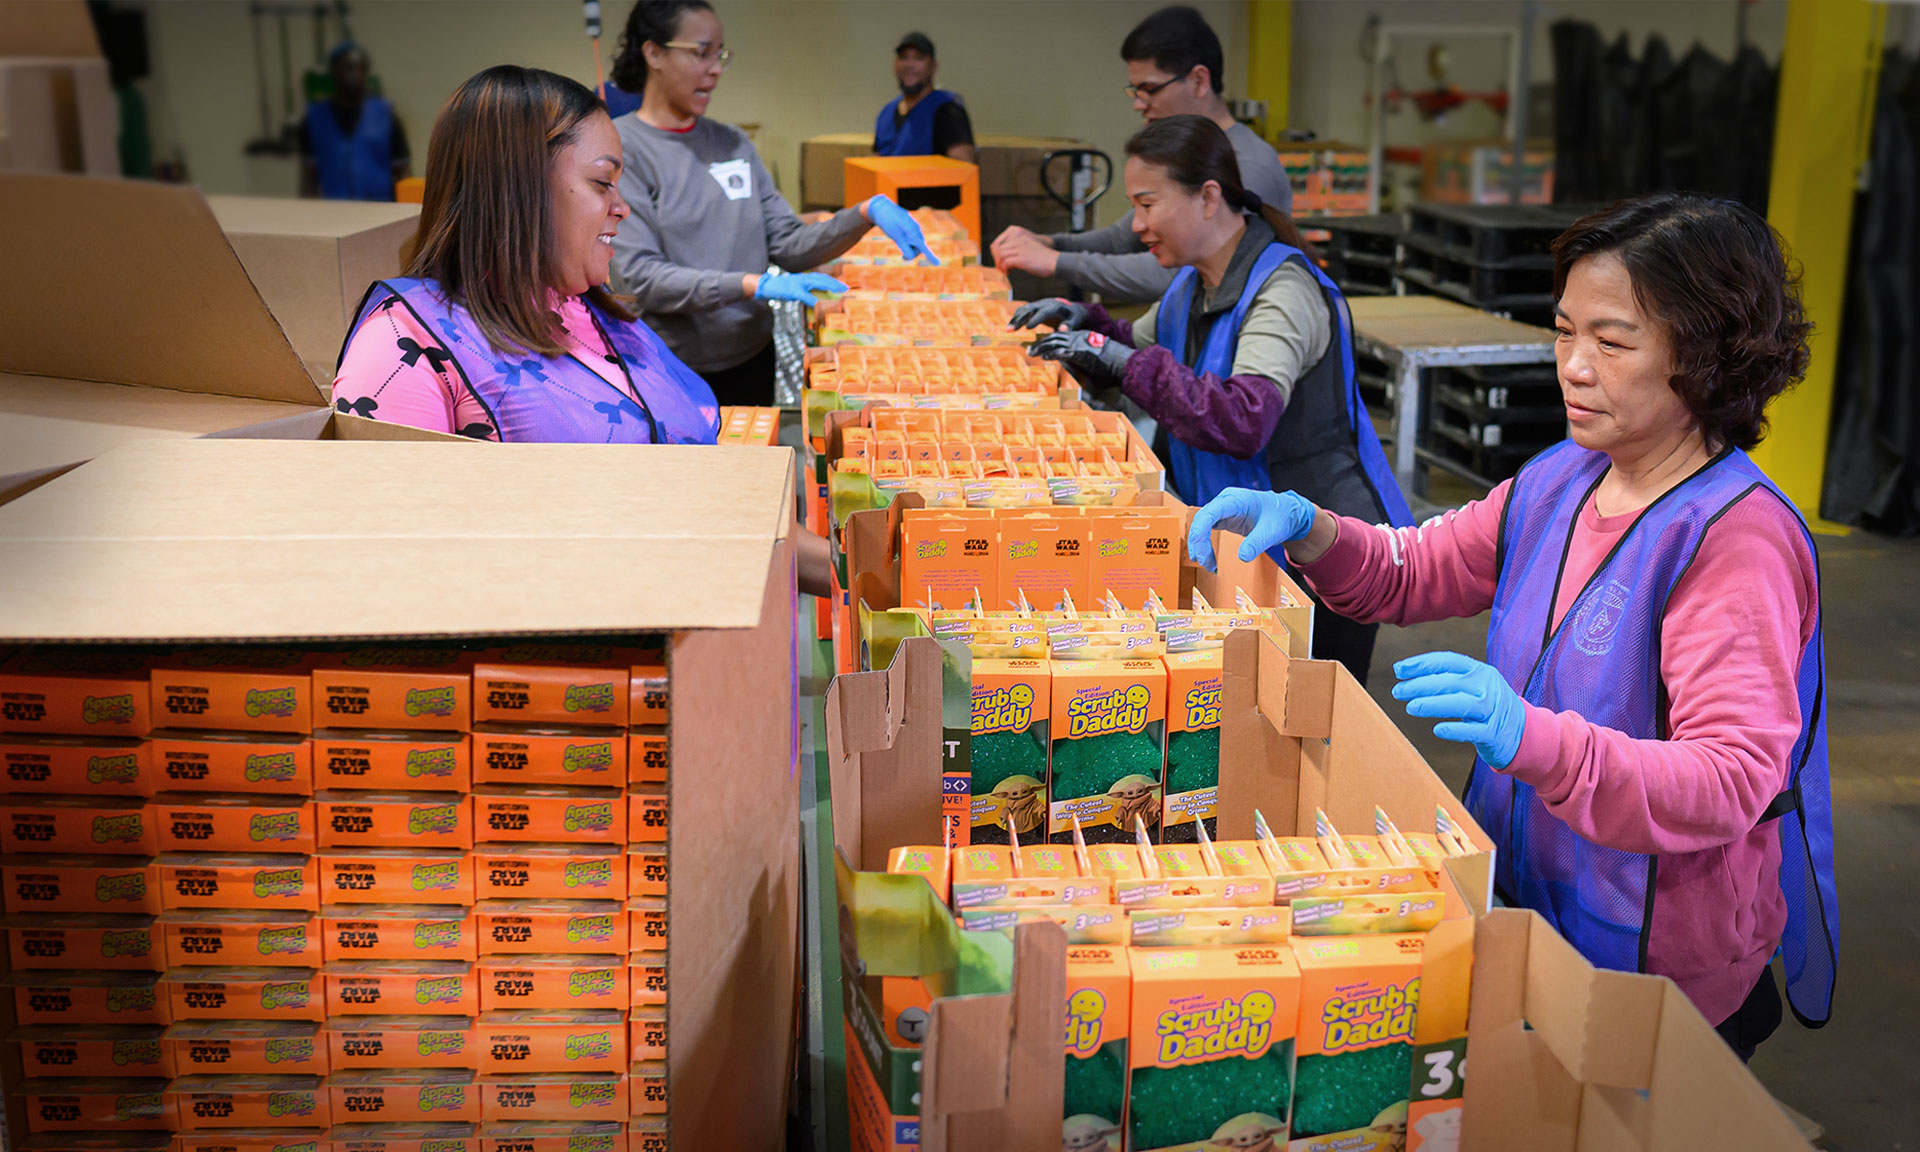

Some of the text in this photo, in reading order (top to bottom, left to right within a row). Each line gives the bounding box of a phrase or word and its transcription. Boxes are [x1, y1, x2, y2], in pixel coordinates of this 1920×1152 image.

[917, 547, 946, 560] Daddy
[1009, 547, 1038, 560] Daddy
[1099, 546, 1128, 559] Daddy
[1013, 636, 1022, 648] 3
[1126, 637, 1136, 649] 3
[1193, 677, 1218, 687] Special
[406, 686, 454, 703] Daddy
[565, 682, 614, 699] Daddy
[1076, 685, 1101, 695] Special
[1085, 690, 1110, 699] Edition
[327, 695, 369, 706] WARS
[487, 691, 529, 702] WARS
[490, 700, 527, 710] STAR
[1068, 689, 1127, 717] Scrub
[330, 704, 367, 714] STAR
[971, 703, 1032, 733] addy
[1070, 704, 1148, 737] Daddy
[406, 748, 455, 764] Daddy
[563, 742, 612, 759] Daddy
[246, 752, 295, 769] Daddy
[328, 757, 371, 768] WARS
[487, 752, 529, 762] WARS
[166, 761, 209, 772] WARS
[490, 760, 527, 770] STAR
[169, 770, 207, 780] STAR
[331, 766, 369, 776] STAR
[1193, 790, 1217, 800] Cutest
[408, 804, 457, 821] Daddy
[564, 802, 613, 819] Daddy
[331, 815, 373, 825] WARS
[488, 813, 529, 823] WARS
[334, 823, 371, 833] STAR
[491, 821, 527, 830] STAR
[411, 862, 460, 878] Daddy
[564, 860, 611, 876] Daddy
[335, 873, 376, 883] WARS
[489, 870, 529, 880] WARS
[338, 881, 374, 890] STAR
[492, 878, 527, 887] STAR
[1378, 874, 1390, 889] 3
[1063, 886, 1075, 902] 3
[1224, 884, 1235, 900] 3
[1398, 900, 1410, 918] 3
[567, 914, 614, 931] Daddy
[1075, 914, 1087, 931] 3
[1240, 915, 1253, 931] 3
[258, 926, 307, 942] Daddy
[414, 920, 461, 937] Daddy
[492, 926, 532, 935] WARS
[181, 936, 223, 946] WARS
[338, 931, 379, 941] WARS
[495, 934, 530, 942] STAR
[184, 944, 221, 954] STAR
[341, 939, 377, 948] STAR
[568, 968, 615, 985] Daddy
[415, 976, 462, 992] Daddy
[494, 980, 534, 989] WARS
[340, 987, 381, 997] WARS
[497, 988, 532, 996] STAR
[343, 995, 379, 1004] STAR
[1322, 984, 1405, 1023] Scrub
[1156, 997, 1241, 1036] Scrub
[565, 1030, 612, 1047] Daddy
[1158, 1017, 1271, 1062] Daddy
[491, 1044, 531, 1053] WARS
[494, 1052, 529, 1060] STAR
[418, 1084, 465, 1100] Daddy
[345, 1096, 385, 1105] WARS
[348, 1104, 383, 1112] STAR
